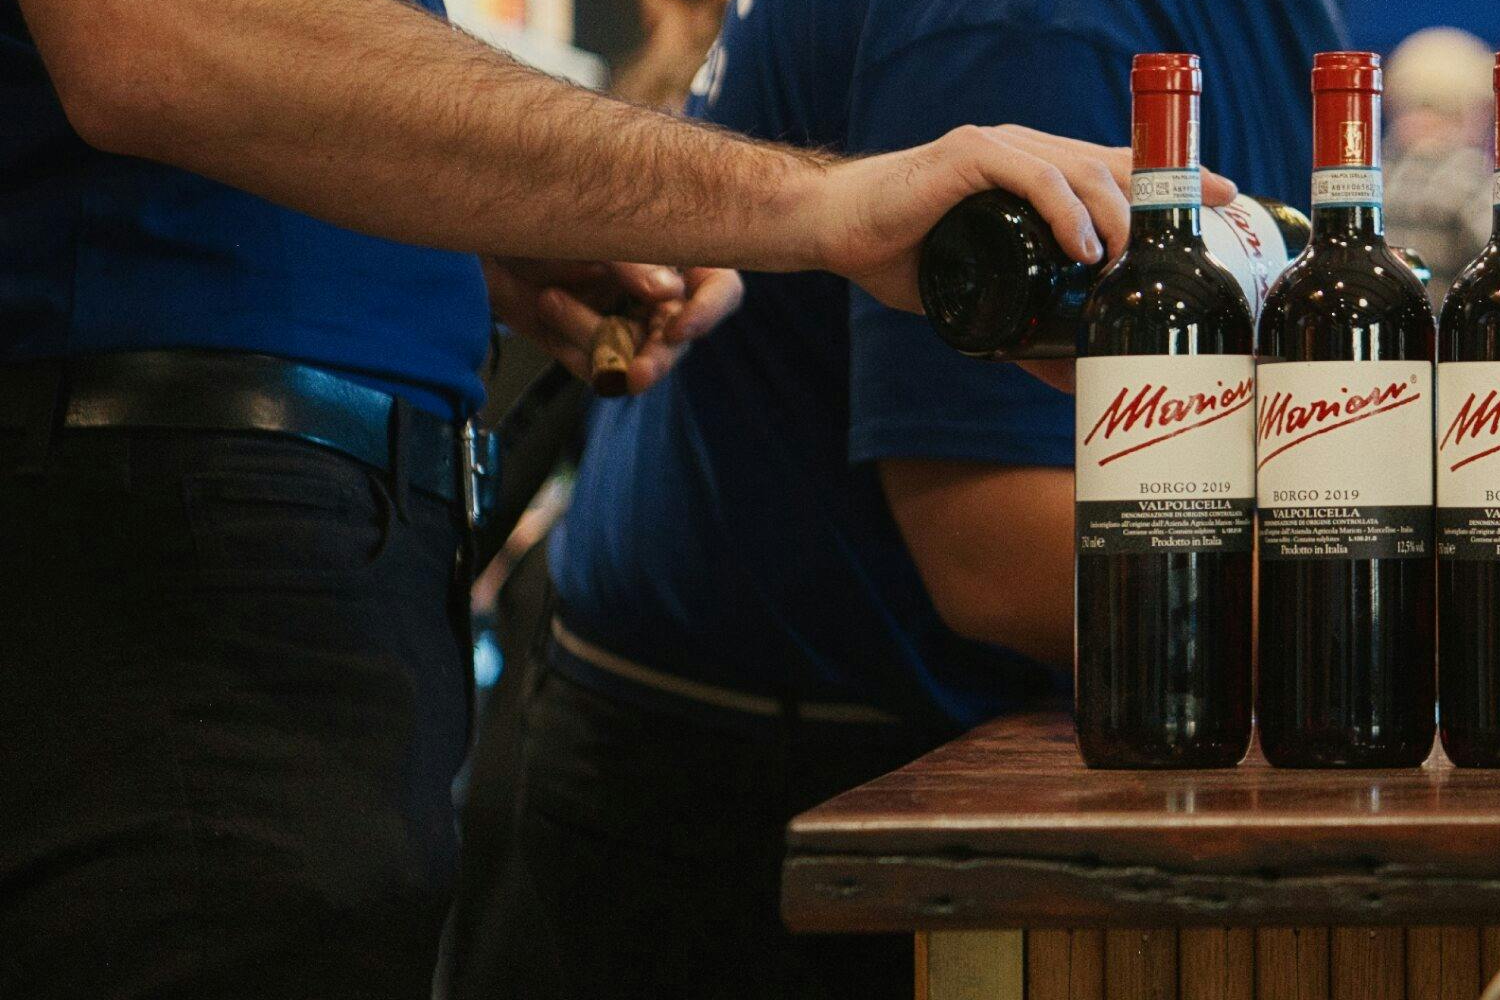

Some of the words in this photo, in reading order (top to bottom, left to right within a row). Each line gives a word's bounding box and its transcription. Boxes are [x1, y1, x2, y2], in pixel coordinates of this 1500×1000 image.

[1257, 382, 1408, 446] Marion
[1140, 483, 1196, 493] BORGO
[1202, 482, 1231, 492] 2019
[1273, 490, 1318, 501] BORGO
[1325, 490, 1359, 500] 2019
[1139, 500, 1232, 511] VALPOLICELLA
[1273, 508, 1360, 519] VALPOLICELLA
[1151, 536, 1191, 547] Prodotto
[1192, 537, 1201, 546] in
[1202, 536, 1222, 546] Italia
[1281, 544, 1313, 555] Prodotto
[1314, 545, 1324, 554] in
[1325, 543, 1348, 554] Italia
